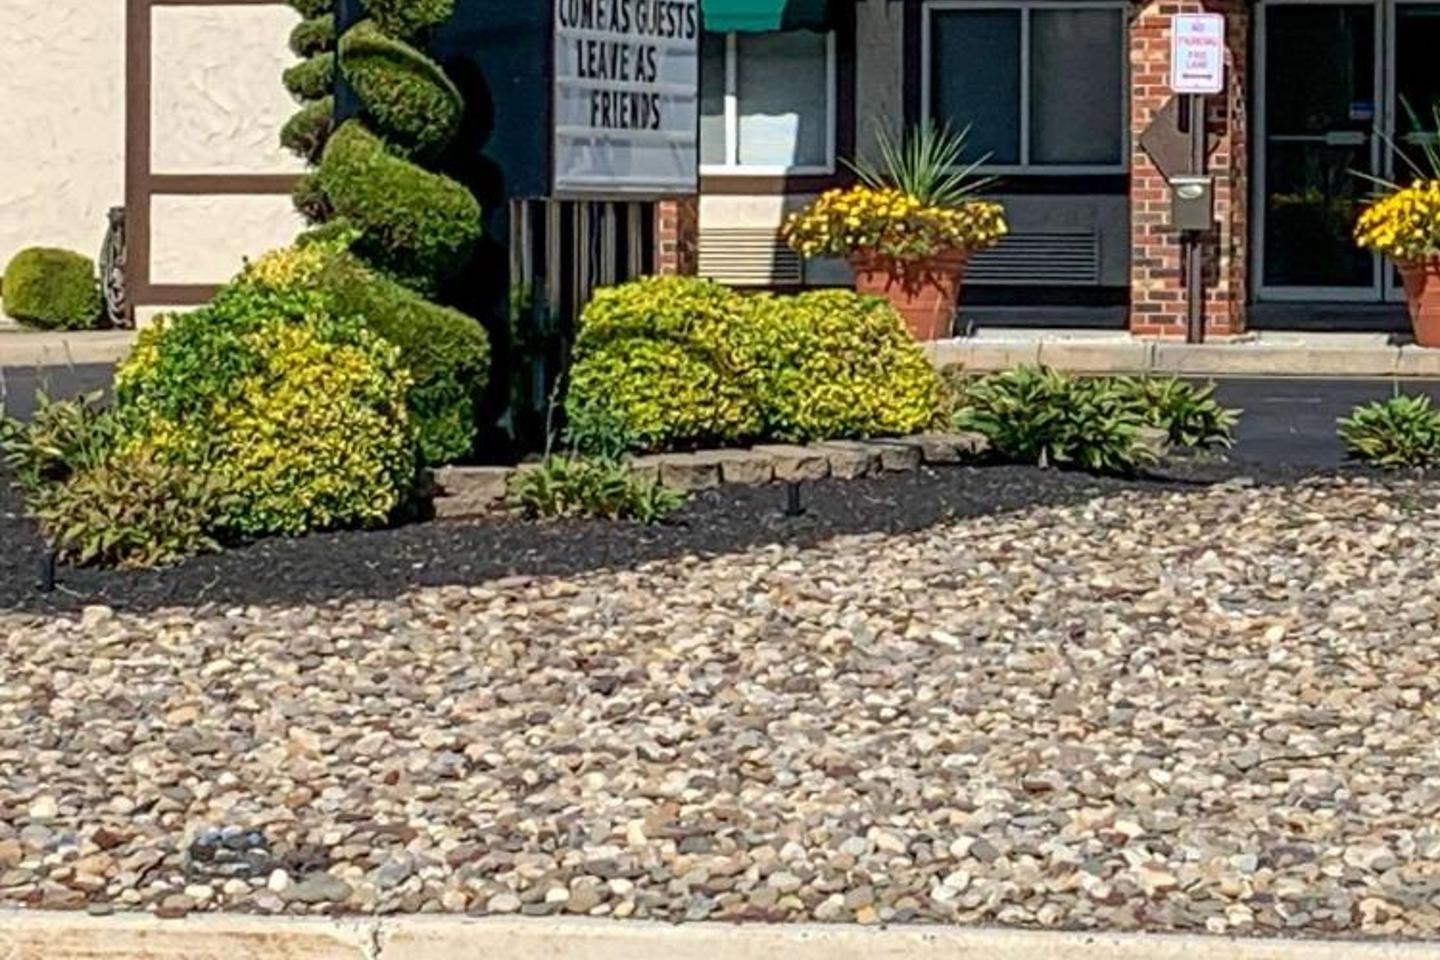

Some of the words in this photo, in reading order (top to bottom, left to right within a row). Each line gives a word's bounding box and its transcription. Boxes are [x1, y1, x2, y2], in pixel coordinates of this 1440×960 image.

[577, 39, 629, 81] LEAVE
[635, 45, 657, 83] AS
[590, 89, 660, 130] FRIENDS
